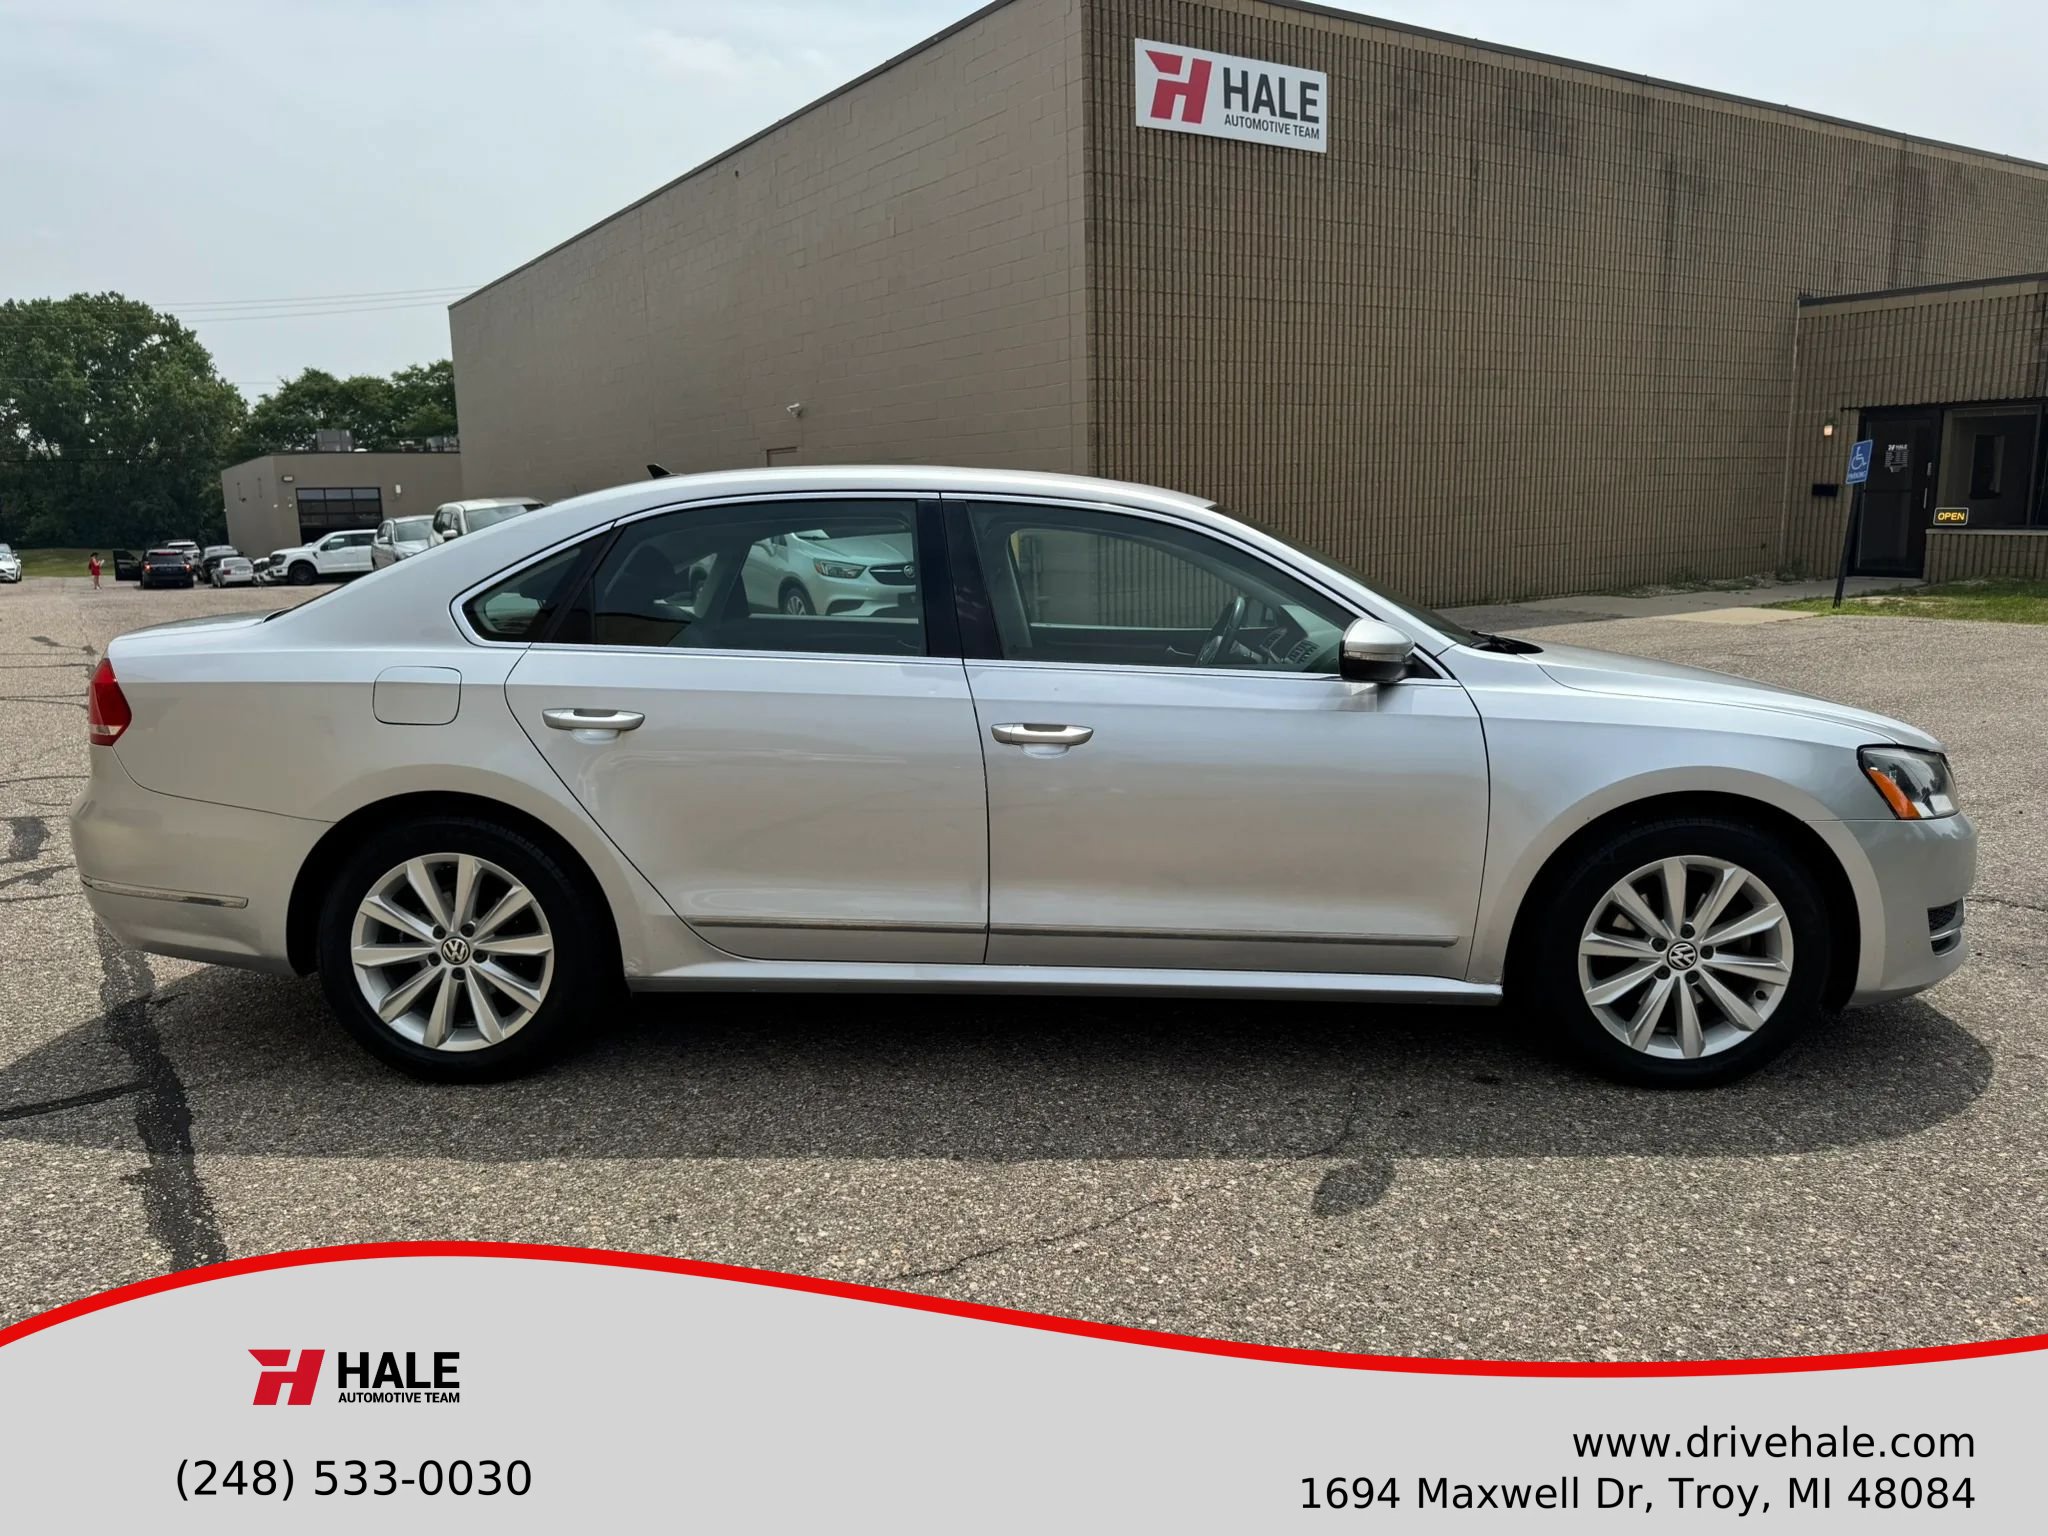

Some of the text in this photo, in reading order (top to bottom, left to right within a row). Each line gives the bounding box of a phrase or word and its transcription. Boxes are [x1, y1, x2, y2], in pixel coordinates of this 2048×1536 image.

[1223, 67, 1320, 124] HALE
[1224, 114, 1320, 140] AUTOMOTIVE TEAM
[1937, 512, 1965, 521] OPEN
